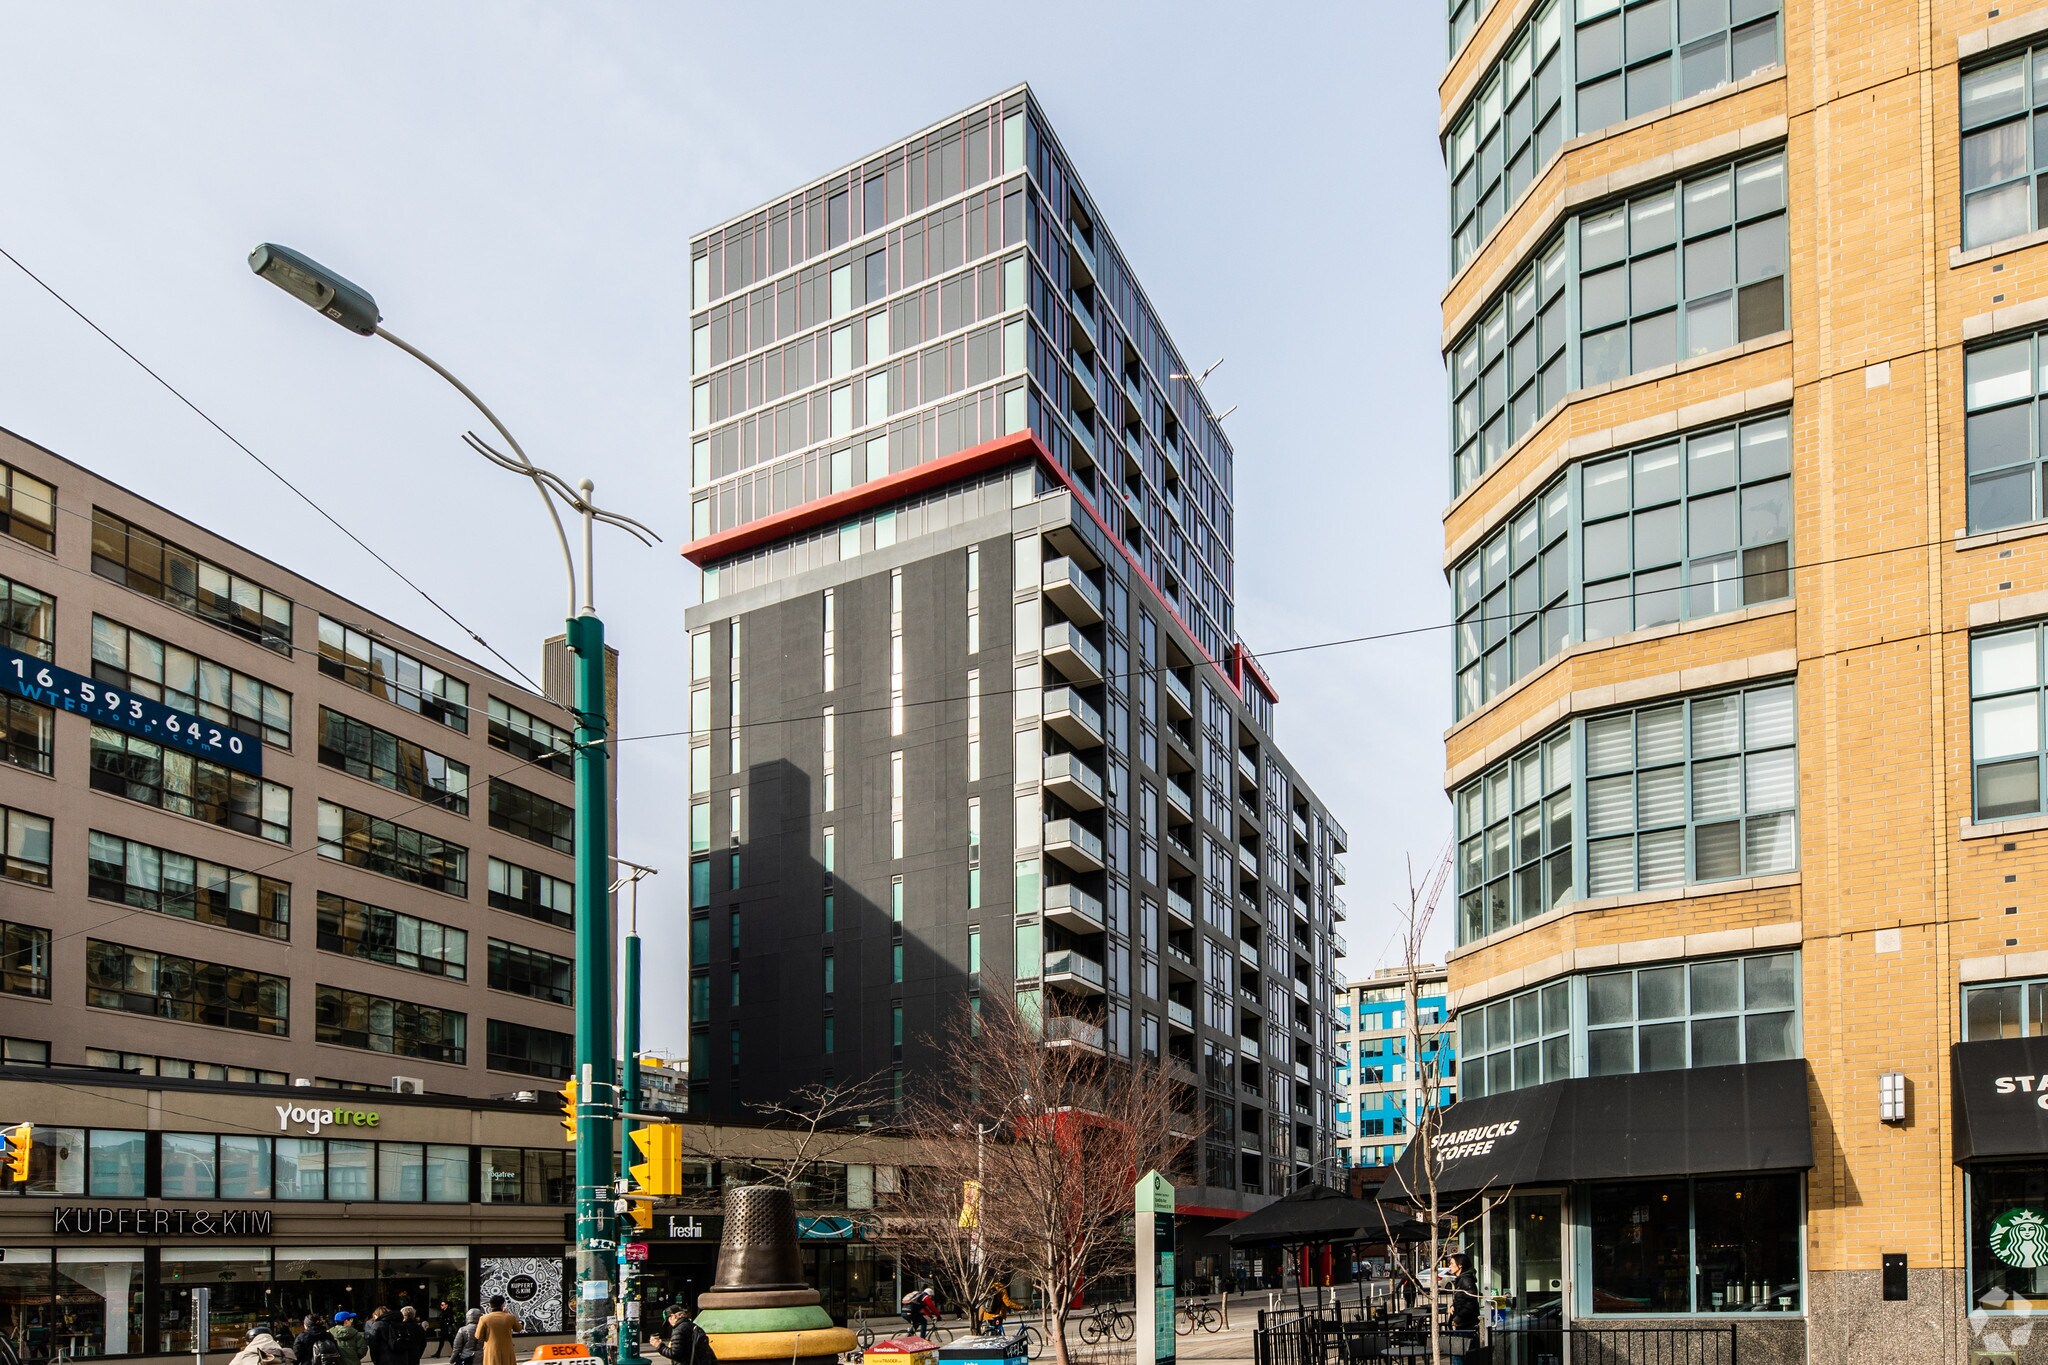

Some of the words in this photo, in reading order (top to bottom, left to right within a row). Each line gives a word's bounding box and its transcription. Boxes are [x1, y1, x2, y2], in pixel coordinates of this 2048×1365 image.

[275, 1102, 379, 1134] Yogatree
[1431, 1120, 1520, 1149] STARBUCKS
[1436, 1140, 1495, 1161] COFFEE
[552, 1346, 579, 1356] BECK
